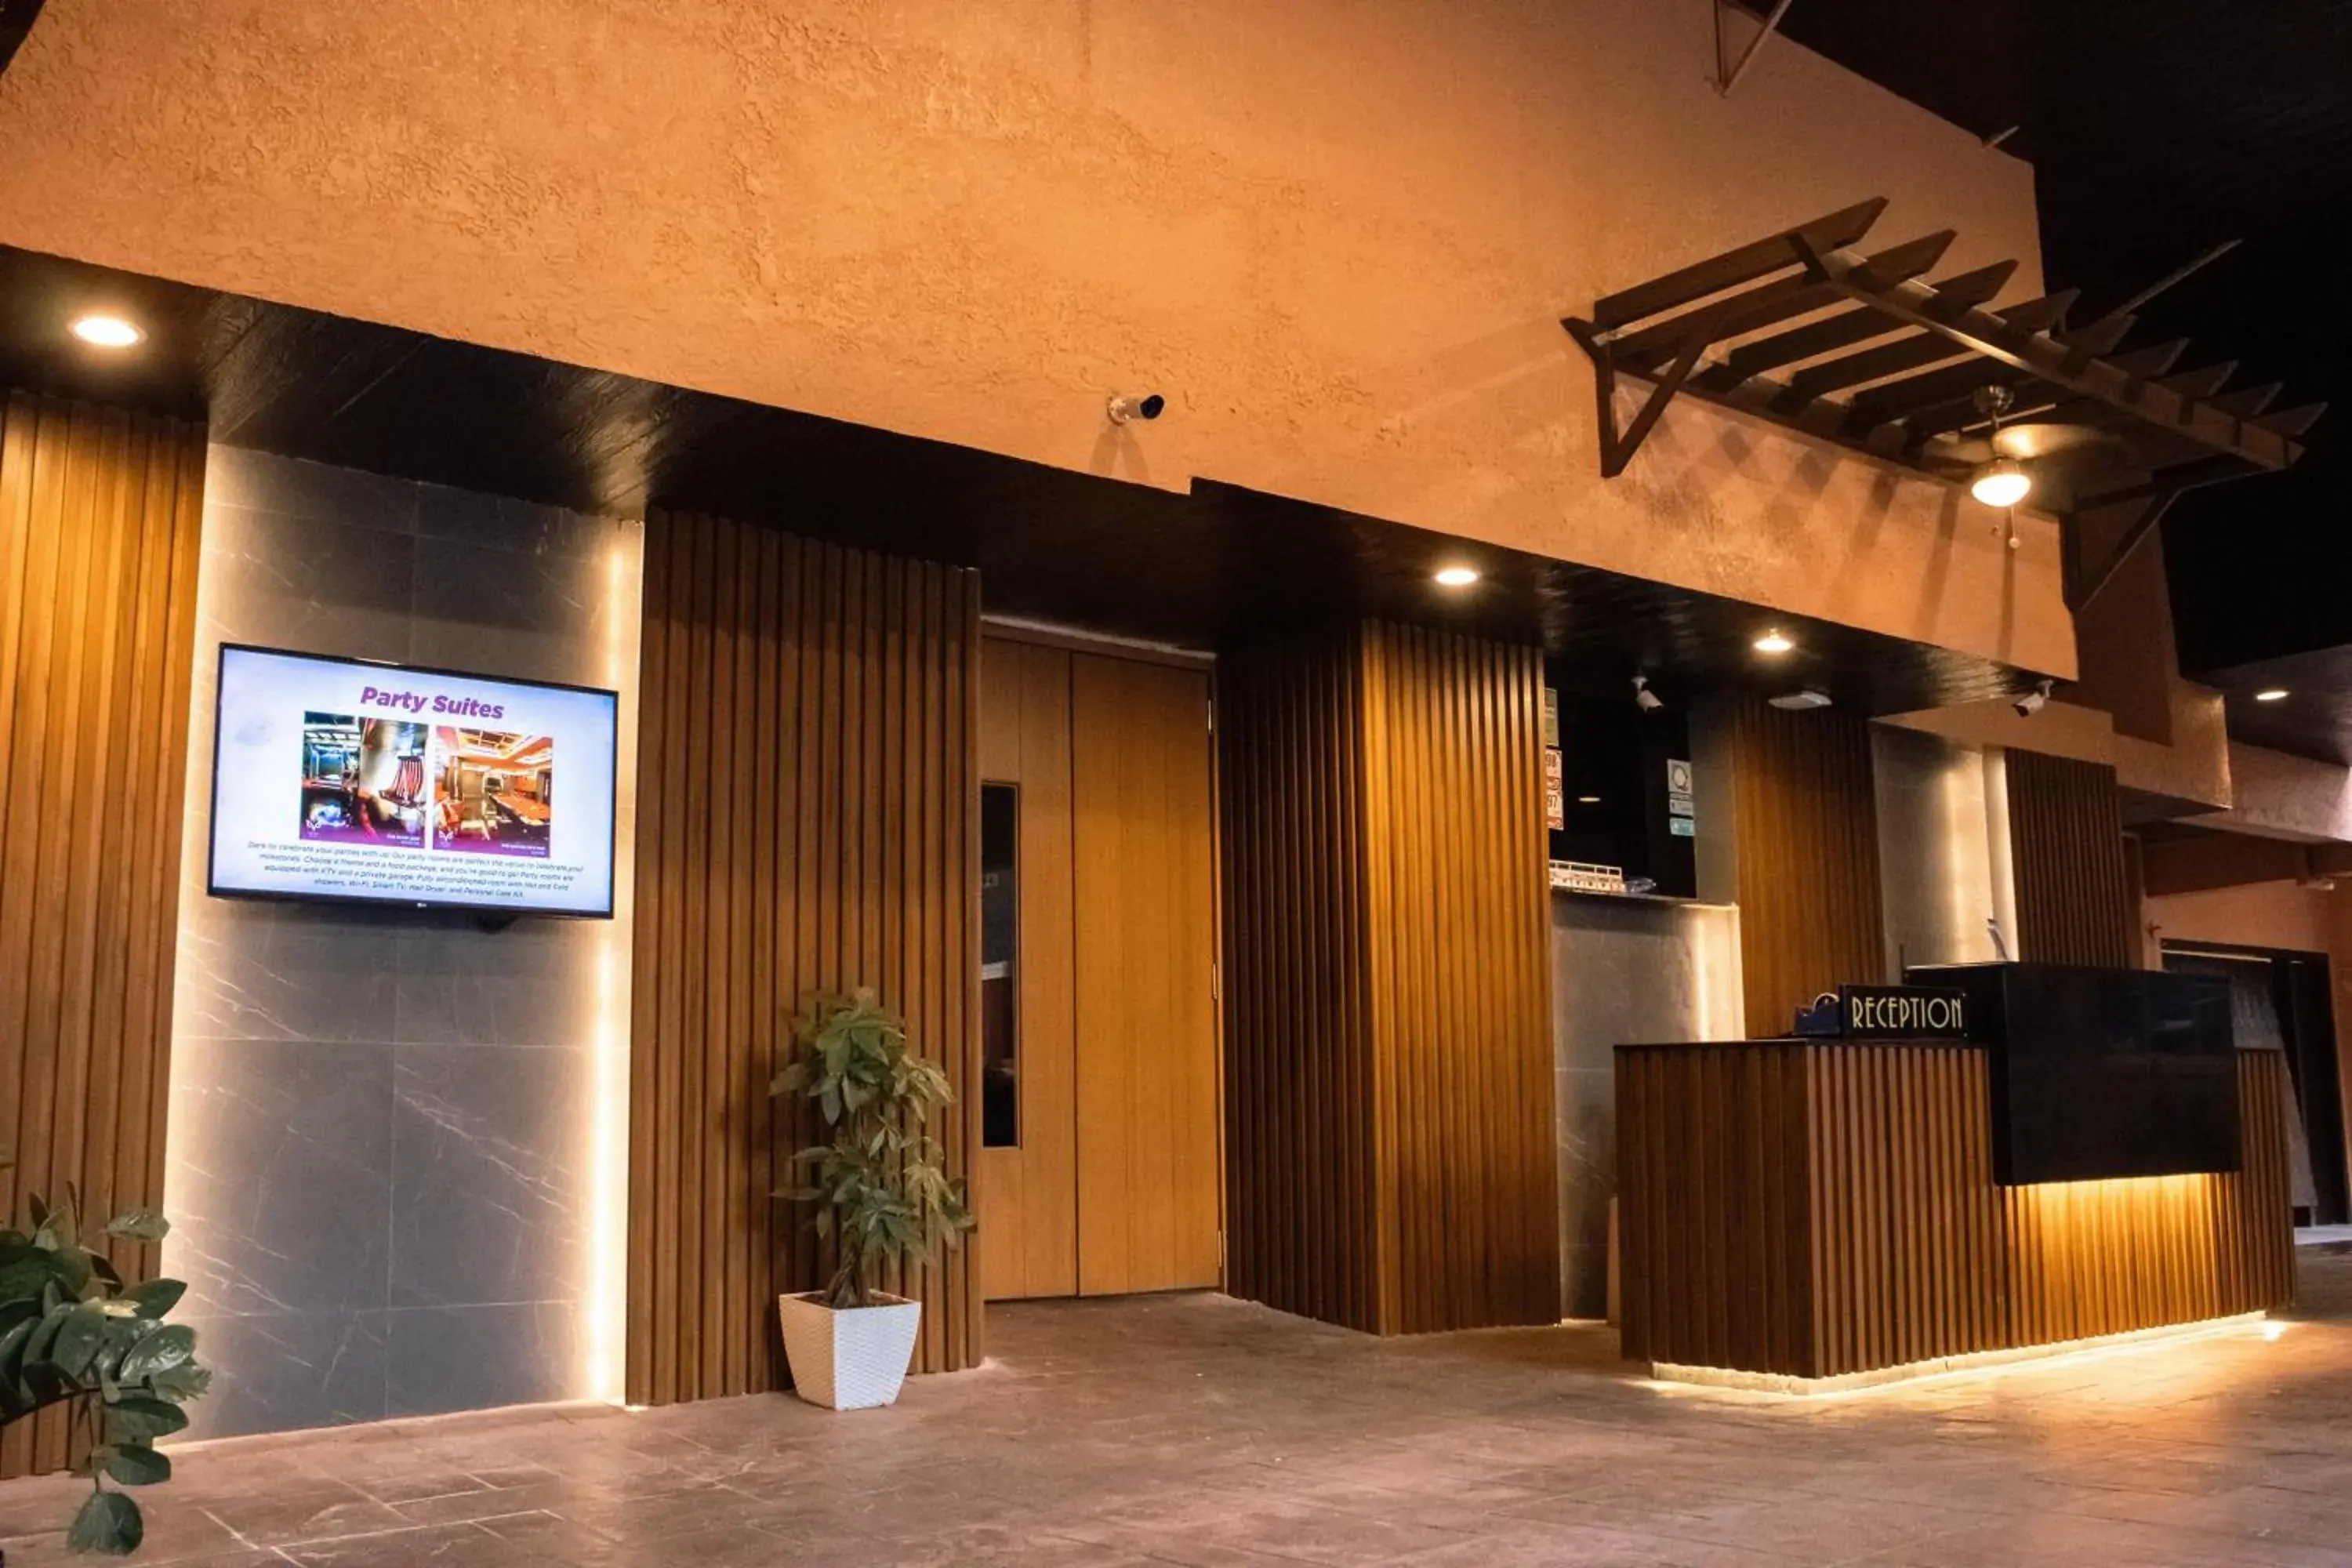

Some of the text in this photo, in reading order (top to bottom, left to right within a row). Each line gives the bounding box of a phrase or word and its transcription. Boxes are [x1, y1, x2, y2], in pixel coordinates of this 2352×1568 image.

[361, 686, 505, 719] Party Suites
[278, 844, 314, 852] celebrate
[360, 870, 387, 879] private
[1852, 996, 1962, 1029] RECEPTION
